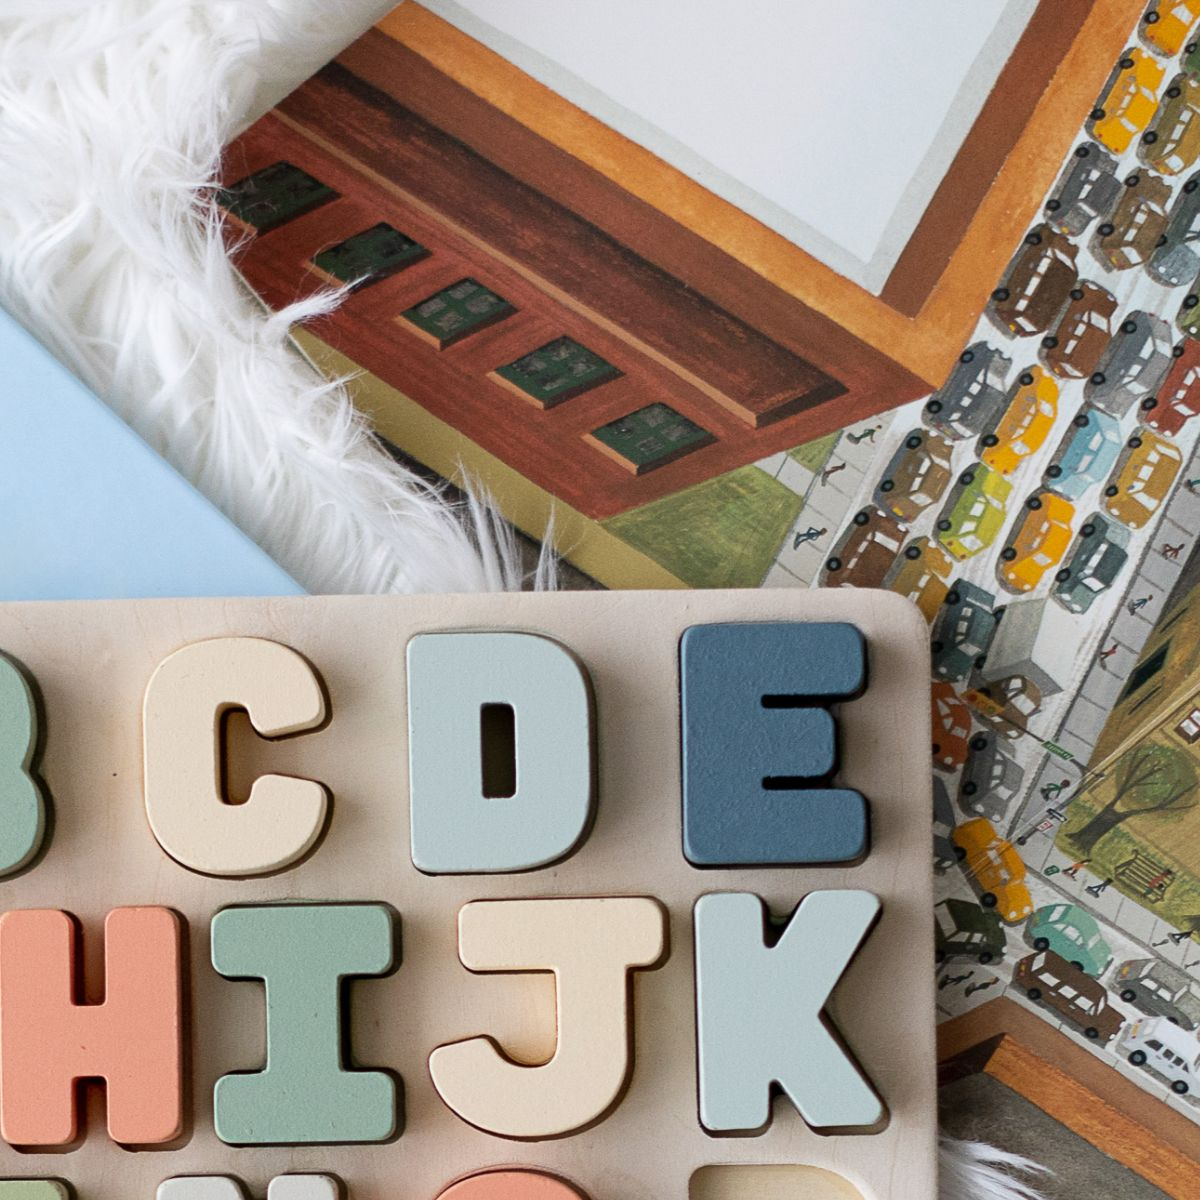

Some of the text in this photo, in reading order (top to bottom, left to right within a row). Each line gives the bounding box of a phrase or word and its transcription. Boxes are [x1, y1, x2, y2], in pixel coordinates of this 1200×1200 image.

[142, 636, 331, 877] C
[406, 631, 597, 874] D
[681, 622, 870, 867] E
[211, 904, 400, 1144] I
[428, 897, 667, 1138] J
[694, 890, 888, 1133] K
